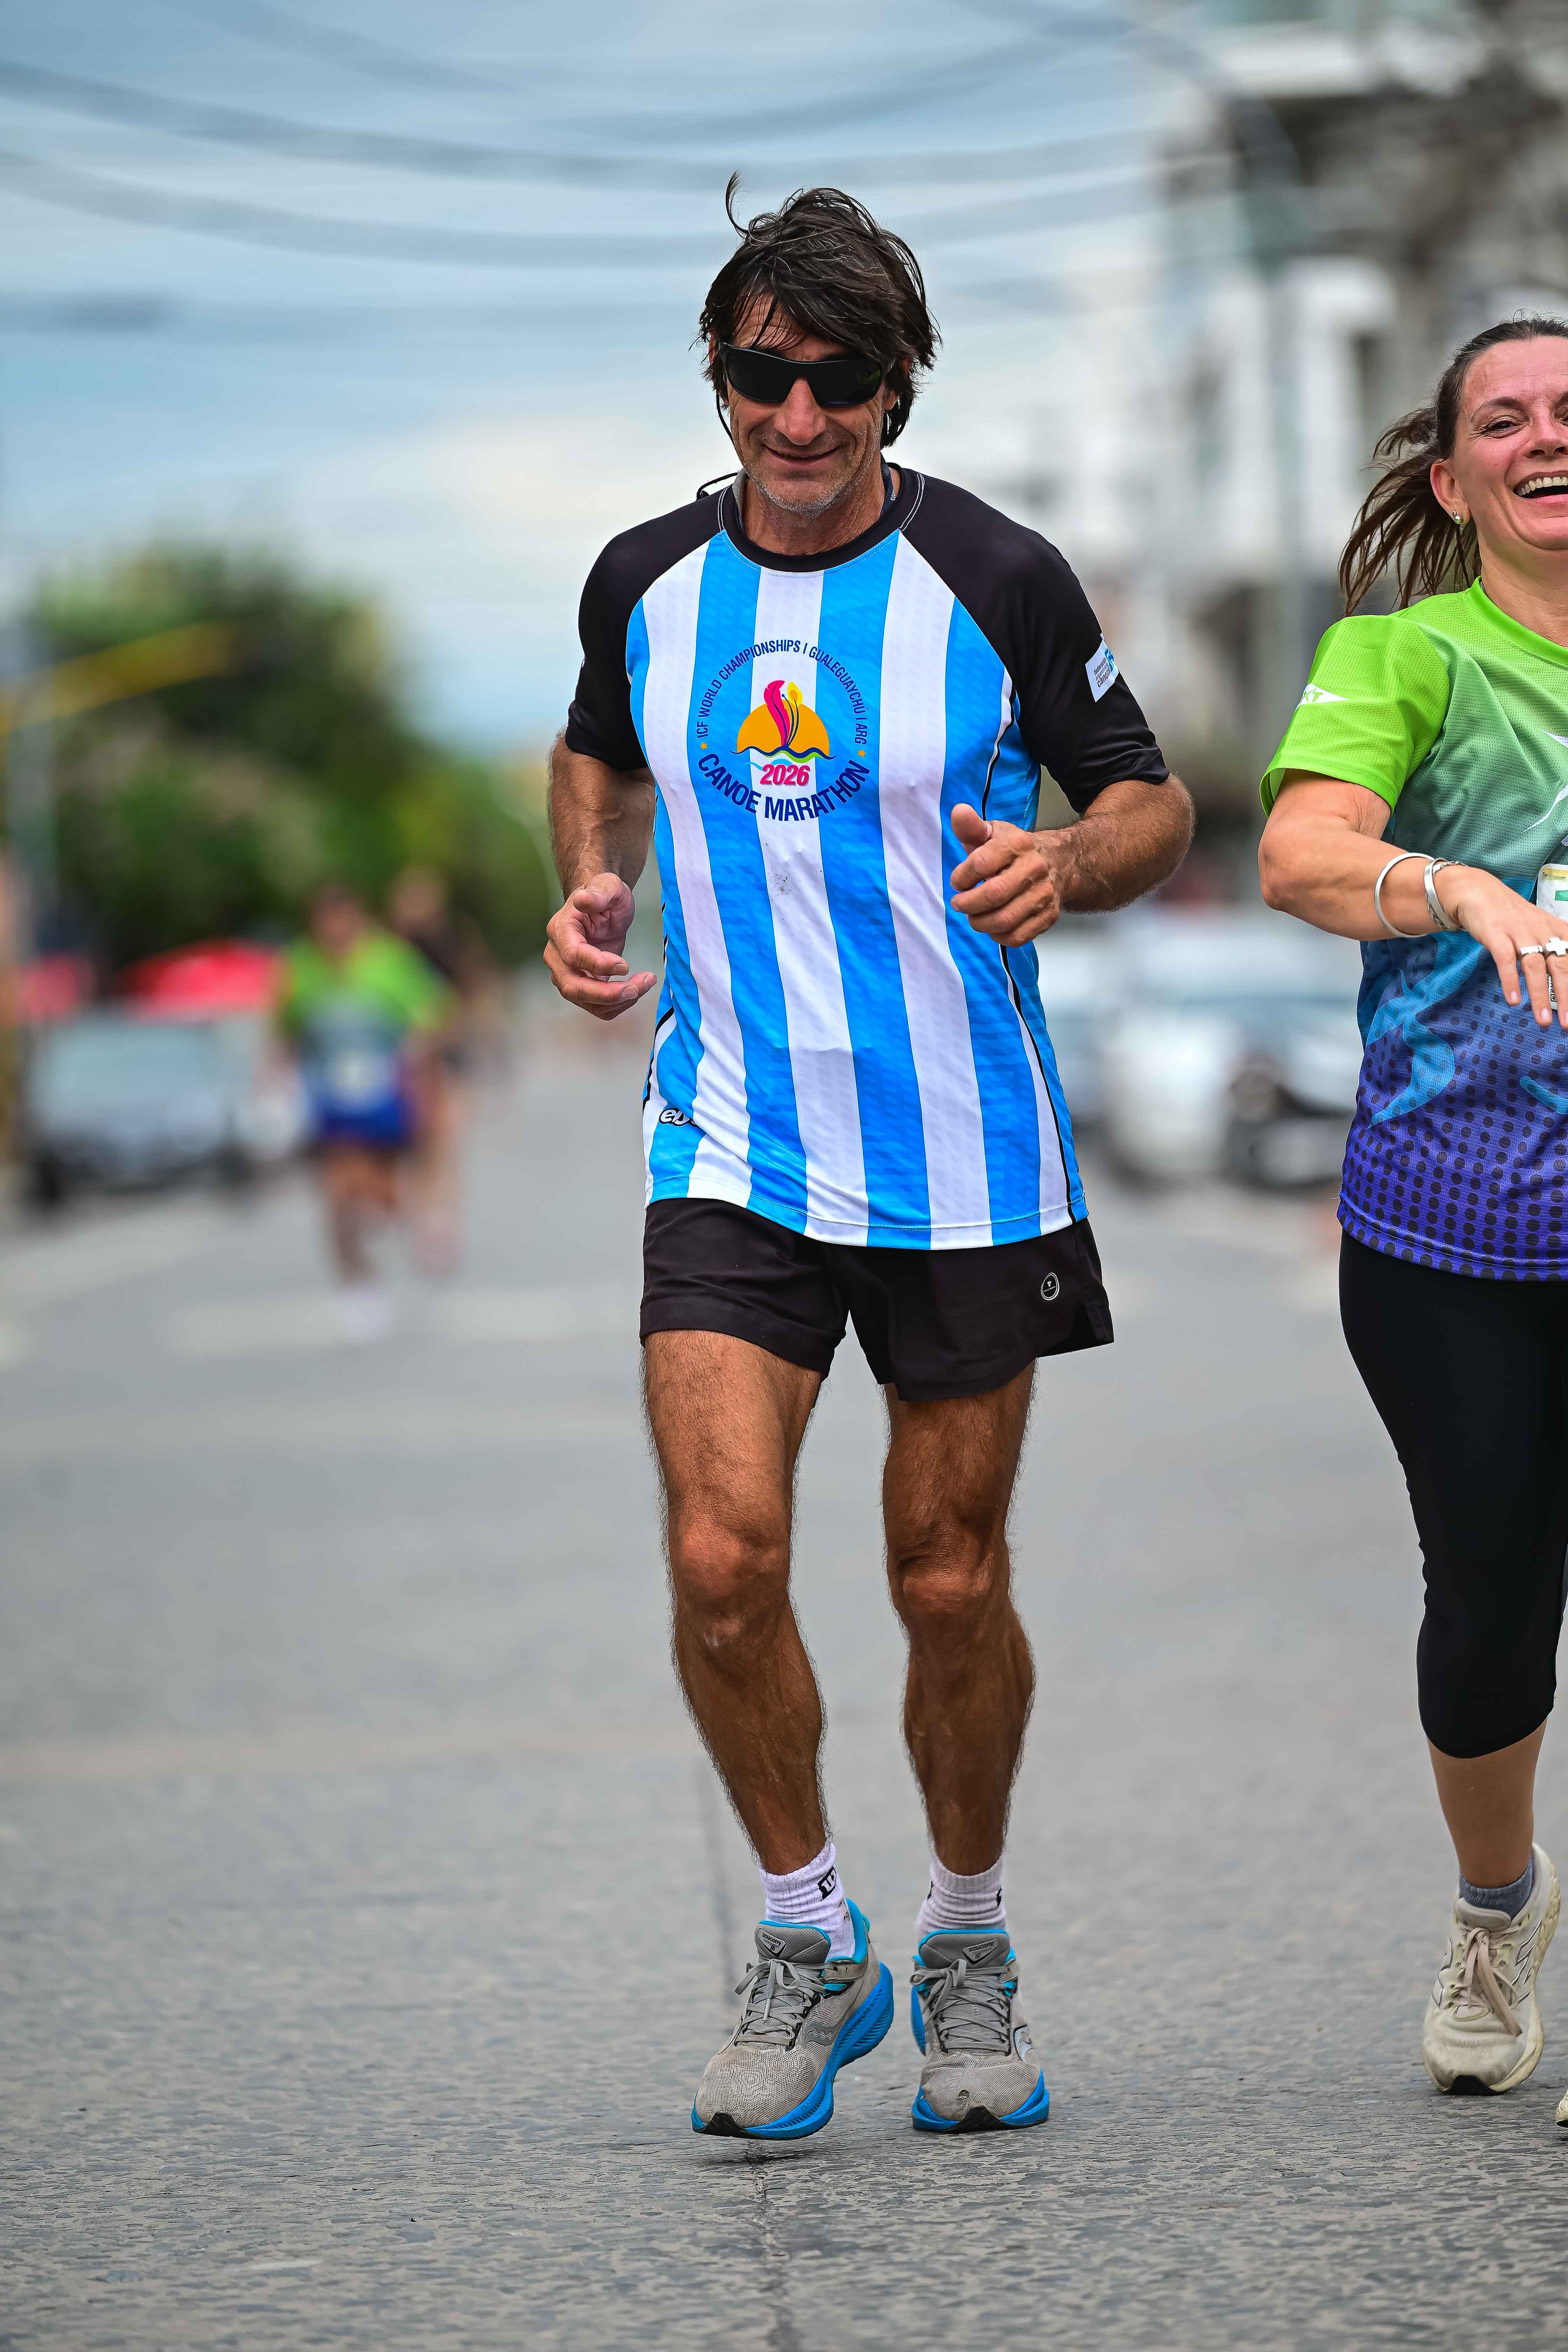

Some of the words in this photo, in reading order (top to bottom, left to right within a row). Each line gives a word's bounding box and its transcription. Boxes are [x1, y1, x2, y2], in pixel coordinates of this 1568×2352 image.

[718, 639, 801, 680] CHAMPIONSHIPS
[809, 646, 869, 714] GUALEGUAYCHÚ
[698, 679, 722, 718] WORLD
[696, 721, 708, 738] ICF
[854, 722, 868, 745] ARG
[760, 764, 811, 786] 2026
[698, 753, 761, 814] CANOE
[765, 759, 871, 821] MARATHON
[762, 1932, 781, 1946] saucony
[968, 1941, 993, 1952] saucony
